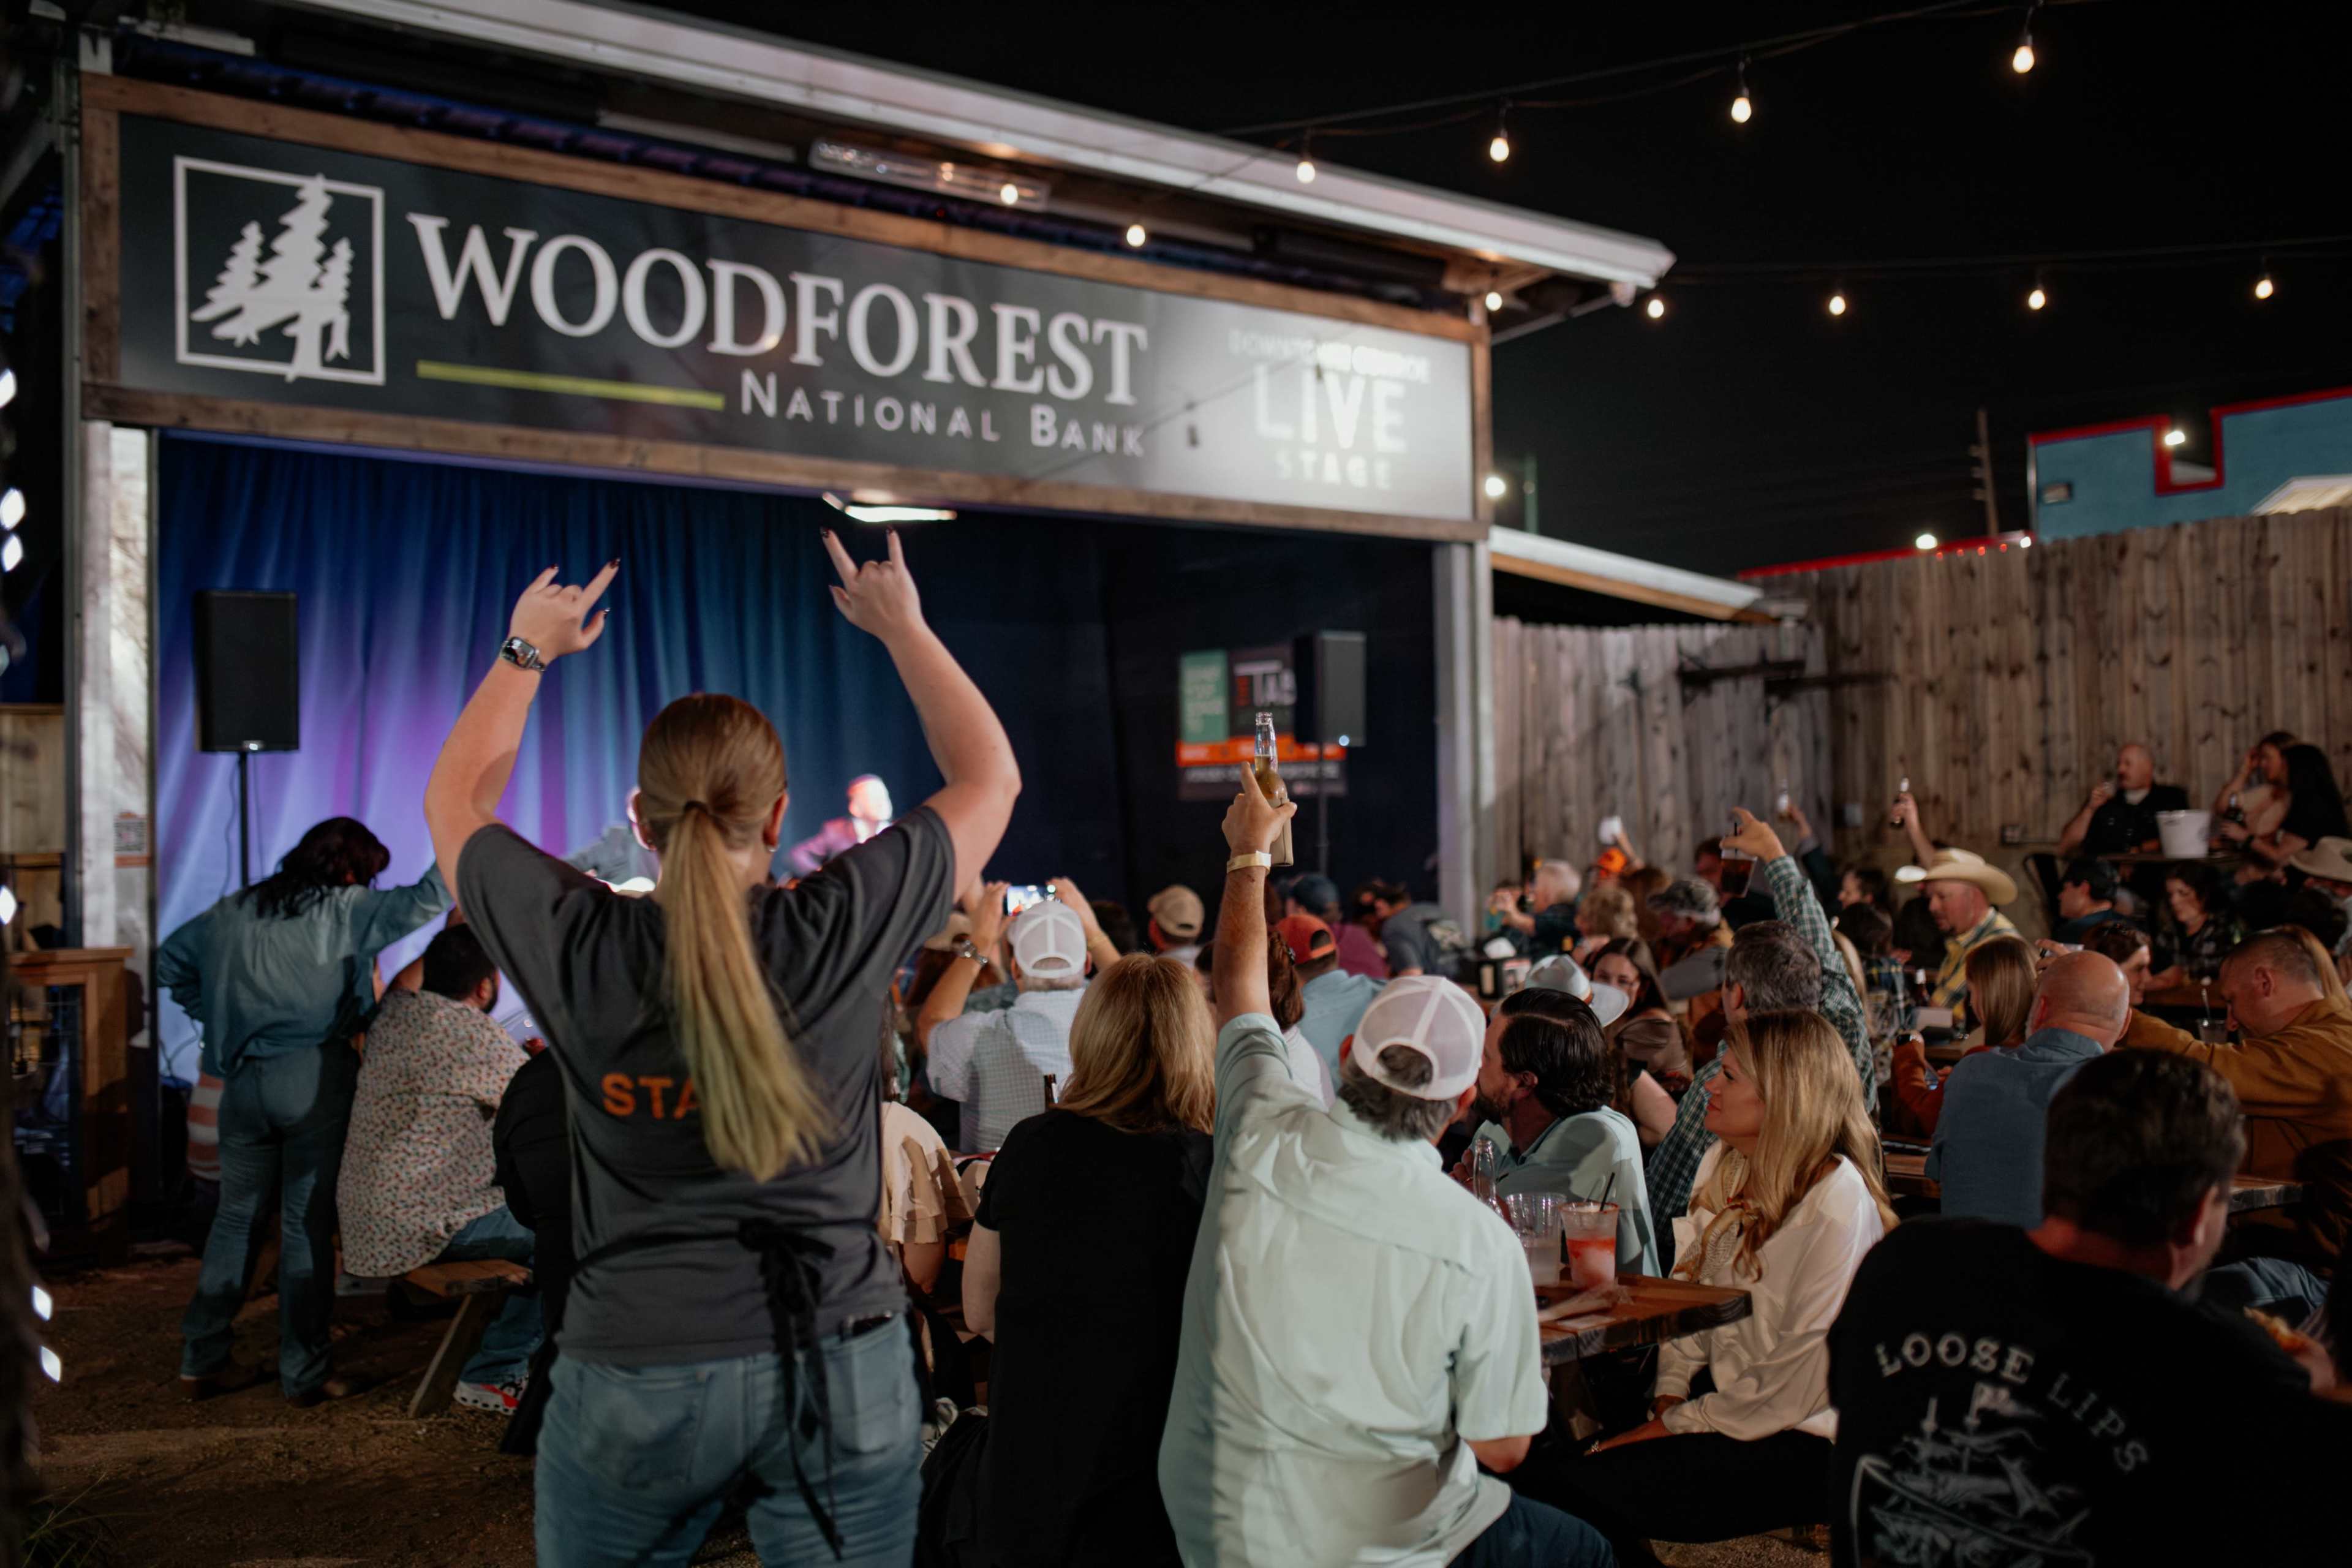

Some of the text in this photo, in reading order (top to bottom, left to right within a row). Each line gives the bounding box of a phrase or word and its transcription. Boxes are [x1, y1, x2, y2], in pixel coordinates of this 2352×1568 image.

[405, 212, 1147, 405] WOODFOREST
[741, 369, 1145, 458] NATIONAL BANK
[1254, 363, 1407, 453] LIVE
[601, 1072, 699, 1120] STA
[1875, 1333, 2148, 1474] LOOSE LIPS
